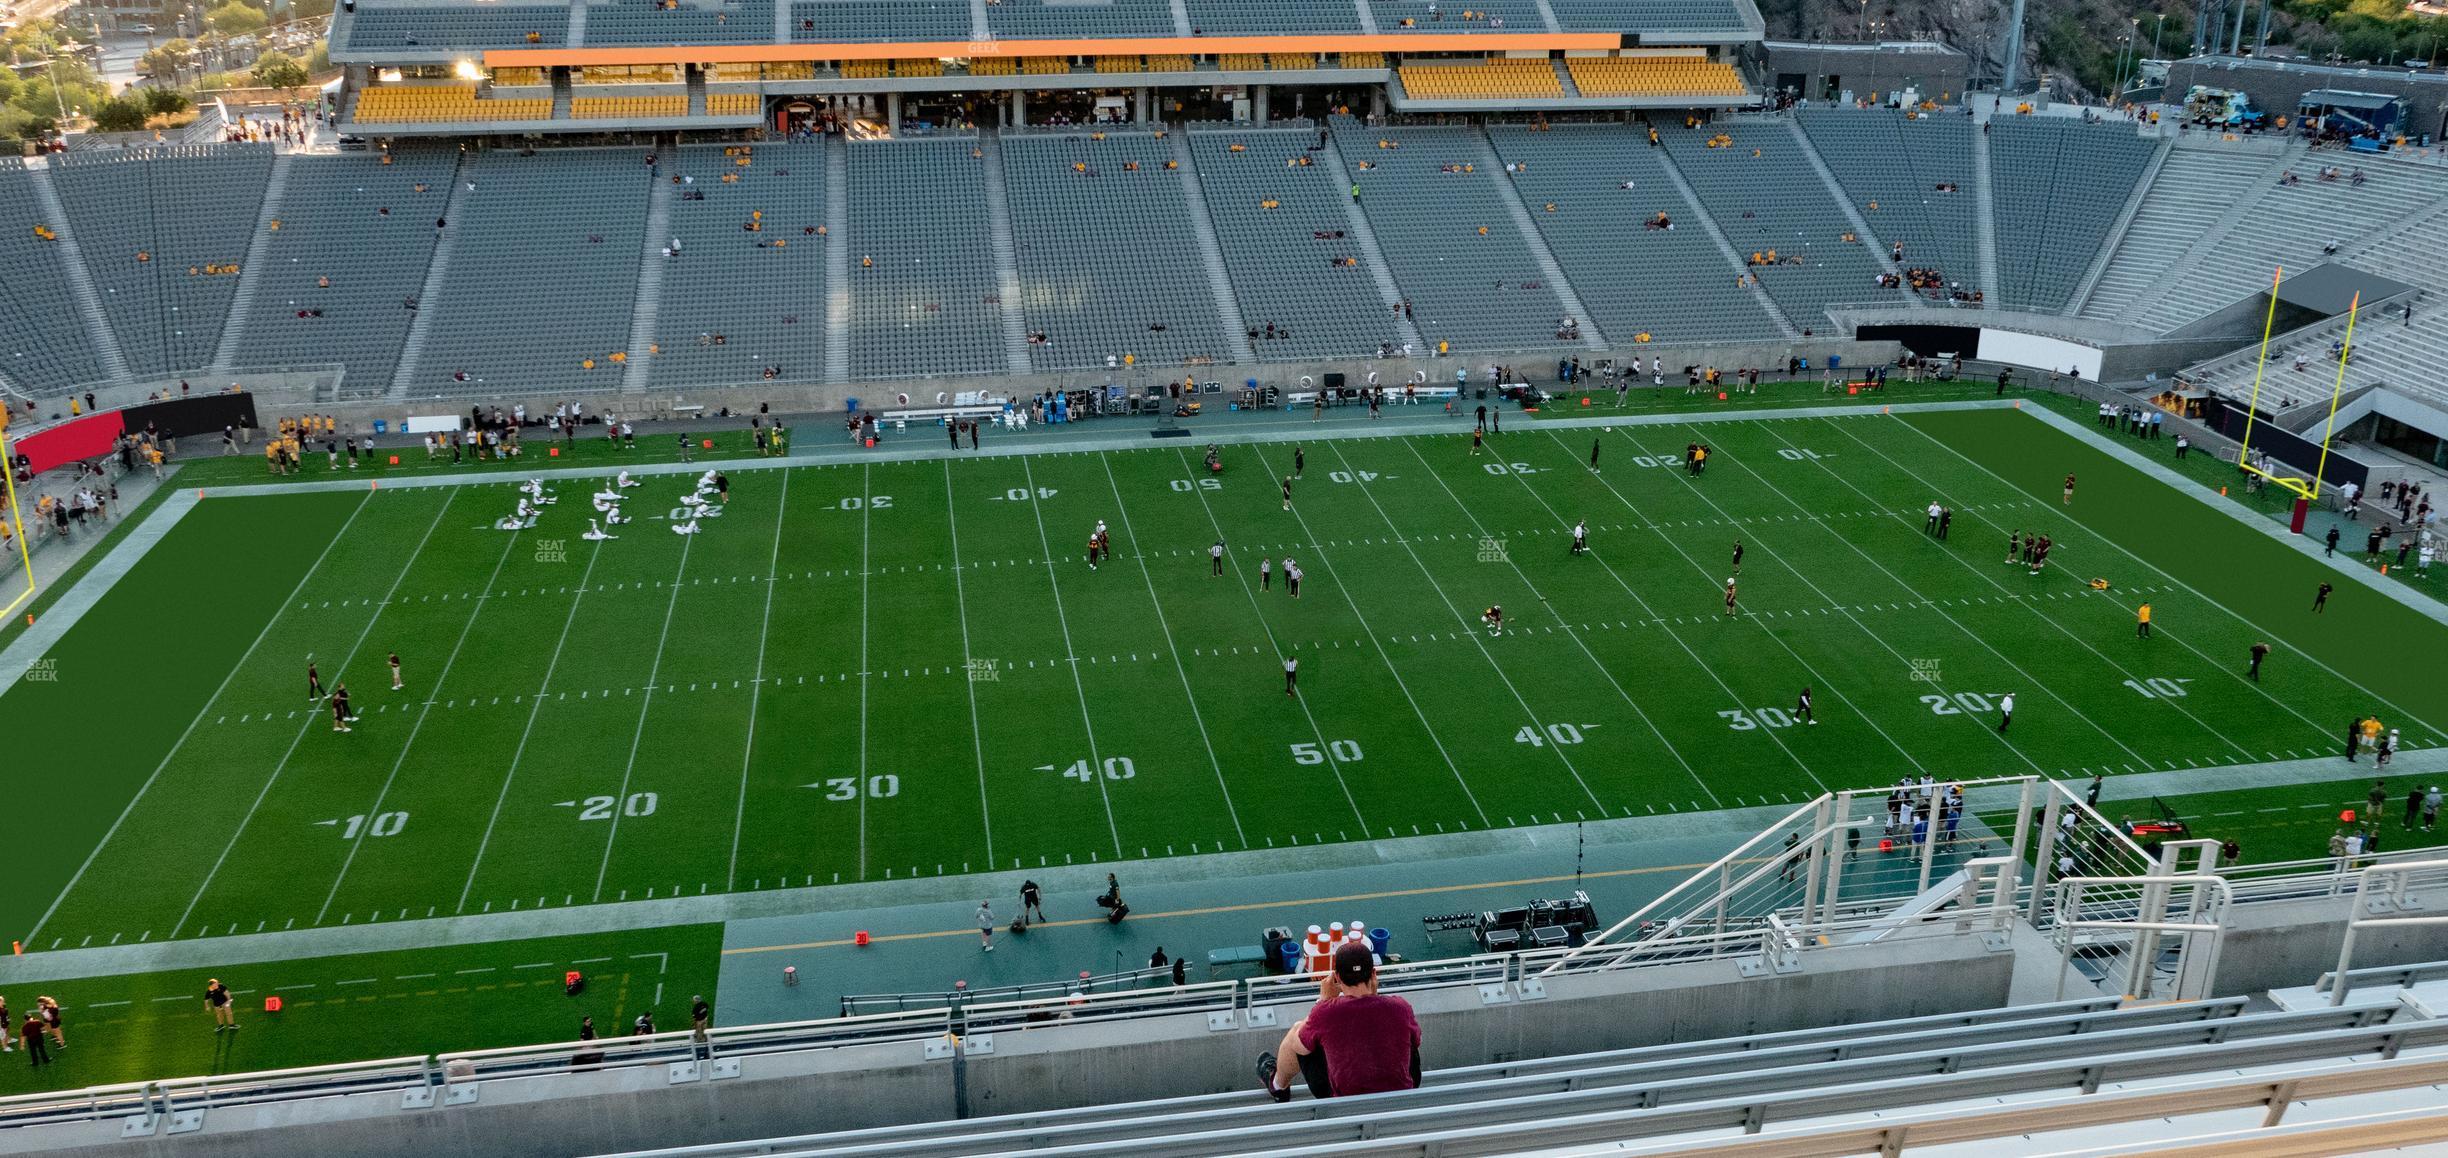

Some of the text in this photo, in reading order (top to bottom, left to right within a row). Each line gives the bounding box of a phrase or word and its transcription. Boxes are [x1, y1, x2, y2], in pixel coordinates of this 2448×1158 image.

[1632, 455, 1686, 468] 20
[1776, 448, 1823, 462] 10
[1329, 470, 1378, 483] 40
[1483, 462, 1537, 476] 30
[1007, 487, 1058, 501] 40
[1170, 479, 1223, 492] 50
[841, 496, 893, 509] 30
[2122, 677, 2188, 699] 10
[1919, 690, 1995, 715] 20
[1716, 707, 1795, 732] 30
[1514, 722, 1585, 748] 40
[1289, 739, 1365, 765] 50
[1063, 756, 1137, 783] 40
[825, 774, 899, 801] 30
[578, 792, 659, 821] 20
[342, 811, 410, 839] 10
[856, 933, 867, 944] 30
[267, 999, 277, 1010] 10
